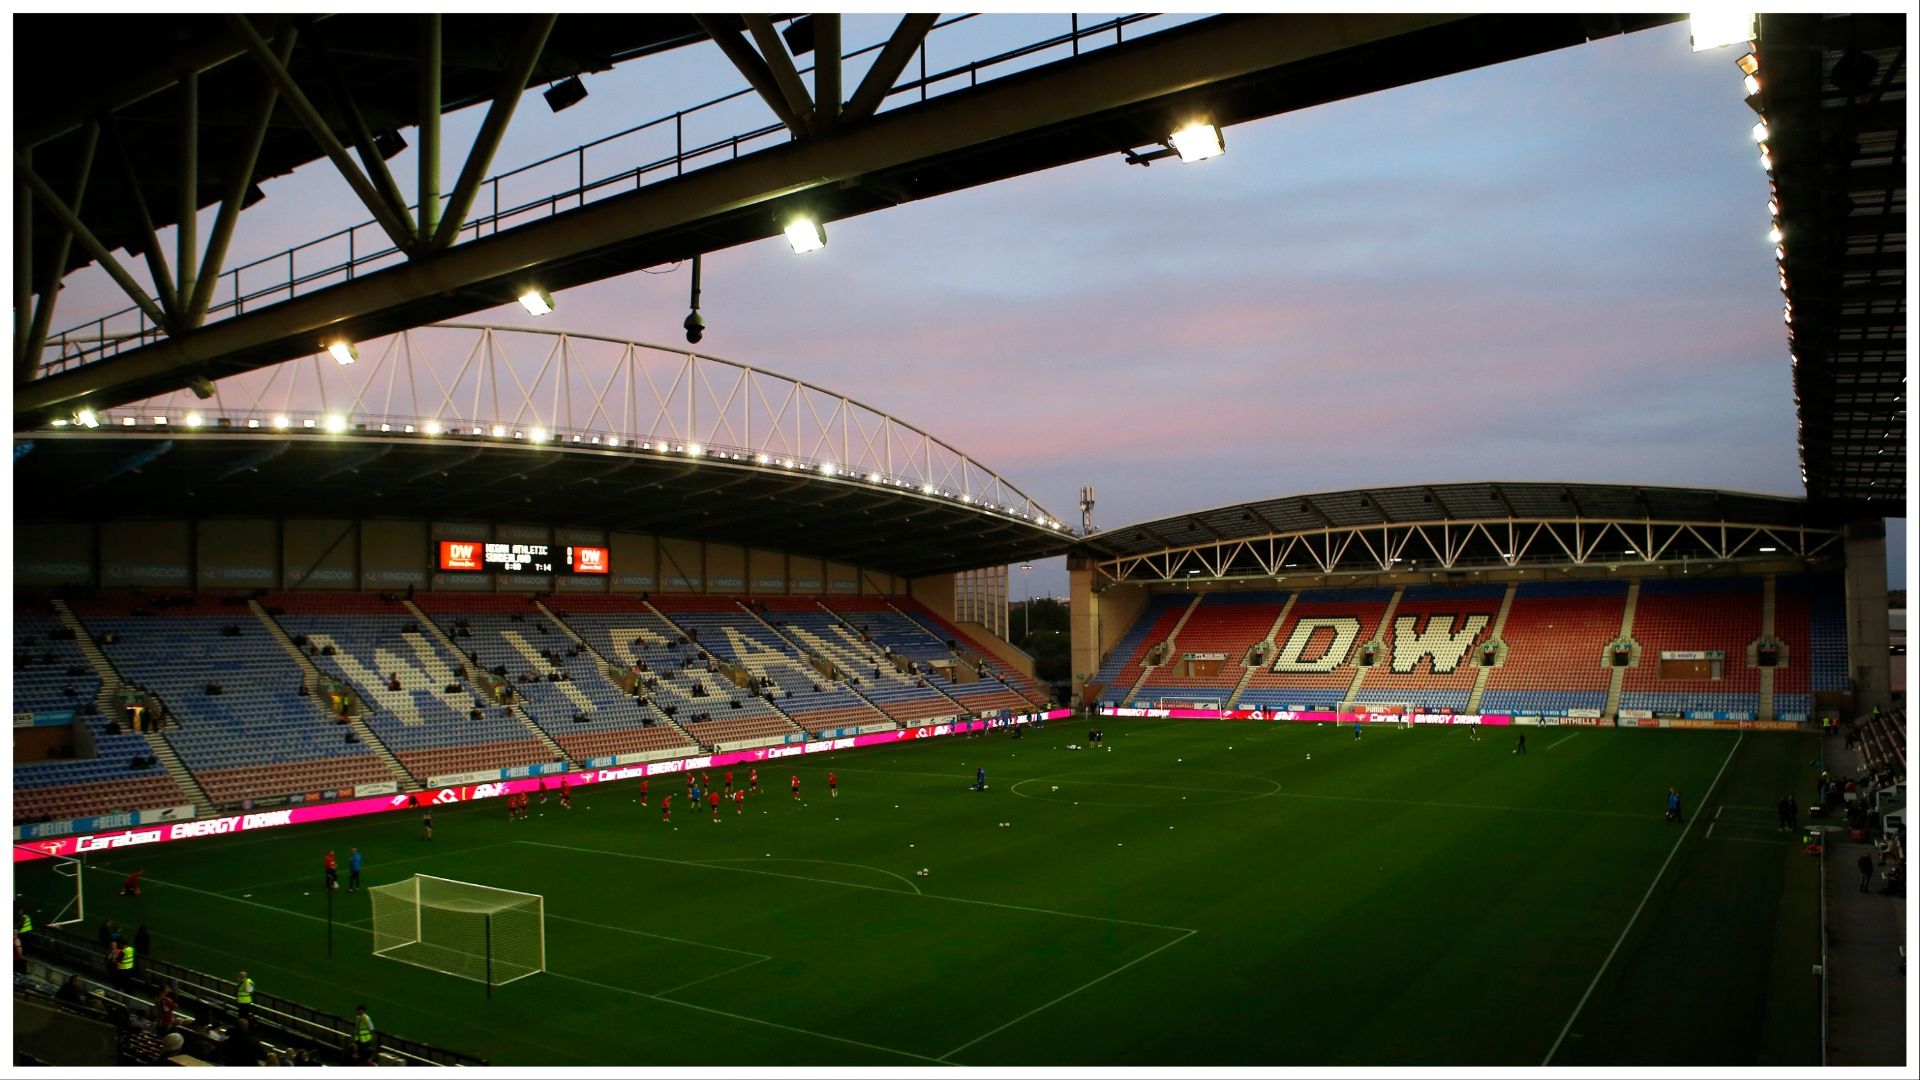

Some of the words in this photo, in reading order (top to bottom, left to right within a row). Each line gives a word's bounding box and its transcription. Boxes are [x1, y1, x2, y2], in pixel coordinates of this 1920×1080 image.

[451, 544, 473, 559] DW
[512, 544, 548, 555] ATHLETIC
[581, 549, 601, 563] DW
[1270, 614, 1491, 674] DW
[304, 624, 914, 727] WIGAN
[1414, 713, 1452, 724] ENERGY
[1453, 714, 1482, 725] DRINK
[1560, 717, 1597, 726] BITHELLS
[805, 740, 834, 753] ENERGY
[599, 767, 643, 782] Carabao
[647, 760, 684, 776] ENERGY
[75, 830, 162, 852] Carabao
[171, 816, 241, 839] ENERGY
[243, 809, 293, 830] DRINK
